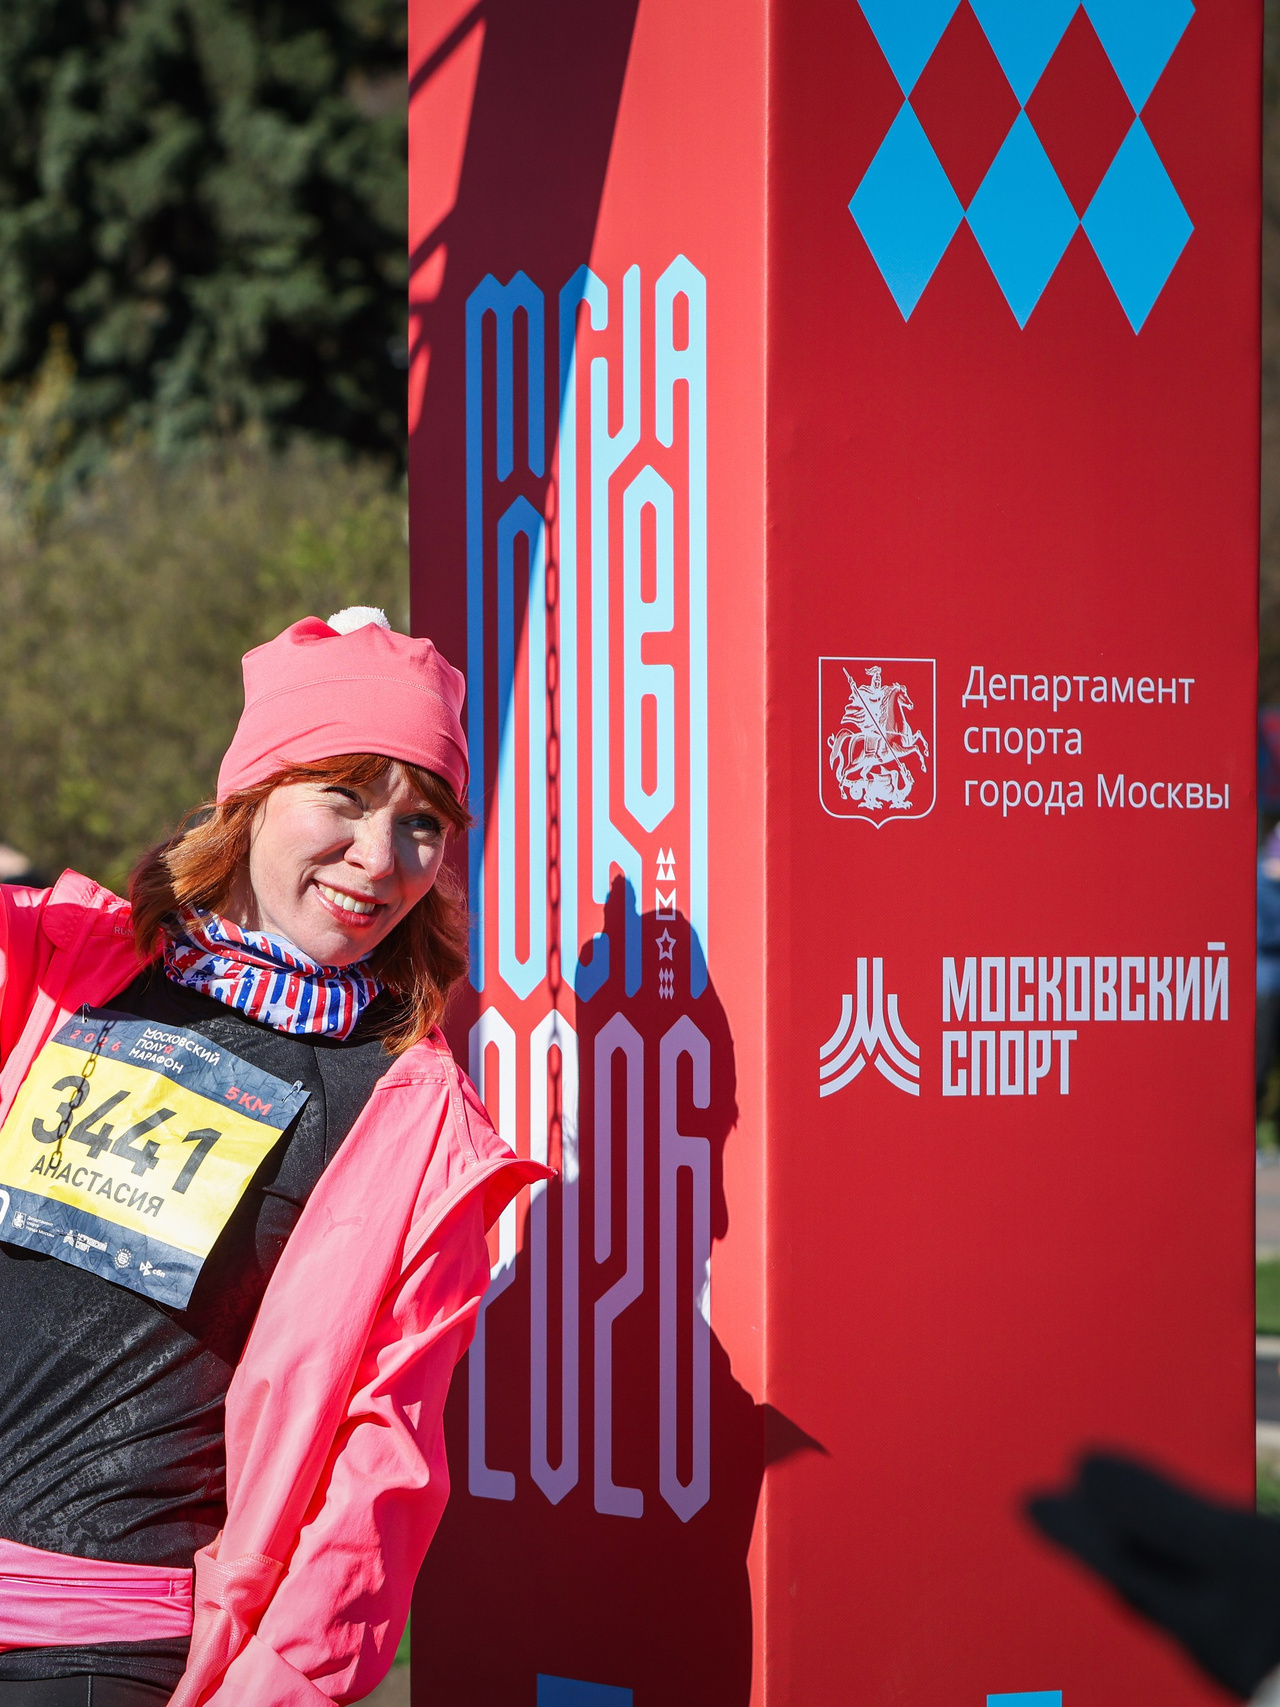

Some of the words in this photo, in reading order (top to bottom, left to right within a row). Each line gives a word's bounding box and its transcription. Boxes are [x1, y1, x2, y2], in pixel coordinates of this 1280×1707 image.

[962, 665, 1196, 712] Департамент
[963, 726, 1084, 765] спорта
[964, 778, 1085, 818] города
[1097, 773, 1231, 810] Москвы
[942, 941, 1229, 1023] МОСКОВСКИЙ
[69, 1029, 122, 1052] 2026
[128, 1048, 185, 1075] МАРАФОН
[135, 1038, 167, 1052] ПОЛУ
[142, 1027, 221, 1066] МОСКОВСКИЙ
[942, 1029, 1078, 1097] СПОРТ
[31, 1074, 223, 1196] 3441
[30, 1154, 165, 1219] АНАСТАСИЯ
[152, 1268, 166, 1279] сбп
[468, 1006, 711, 1524] 2026
